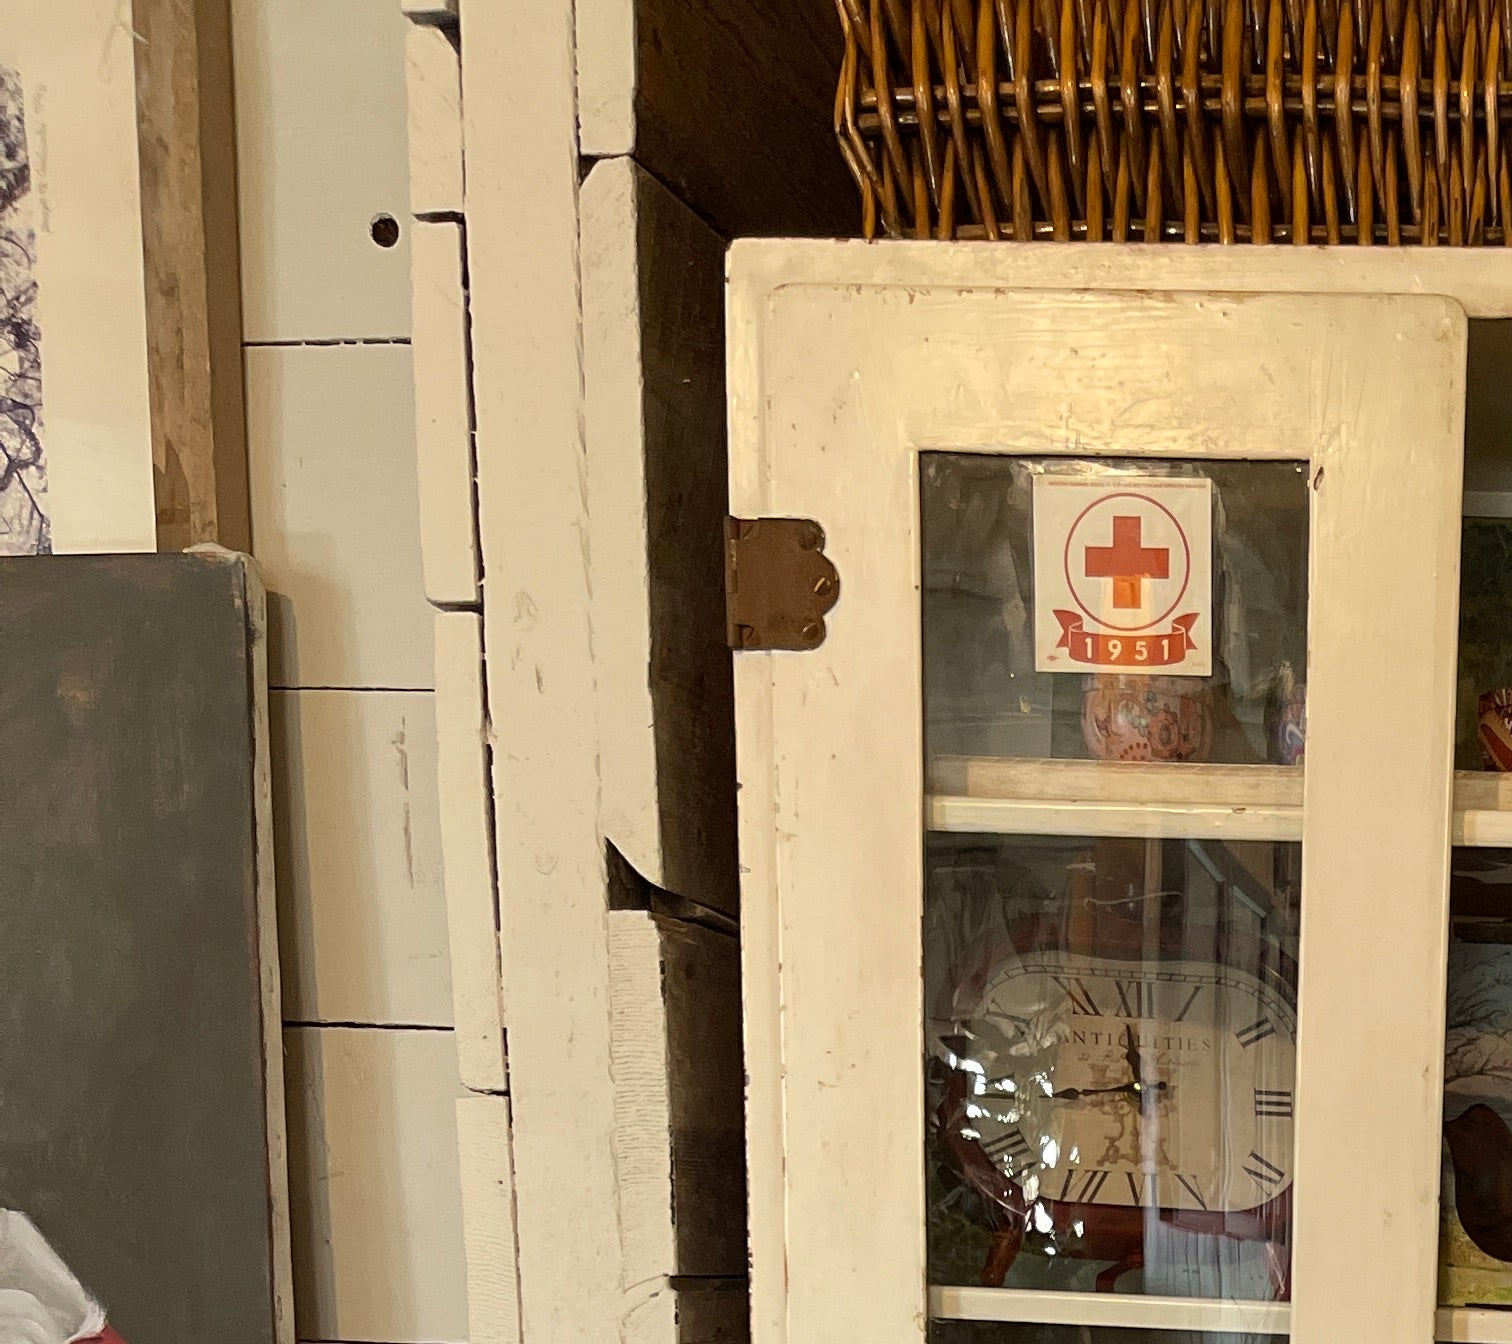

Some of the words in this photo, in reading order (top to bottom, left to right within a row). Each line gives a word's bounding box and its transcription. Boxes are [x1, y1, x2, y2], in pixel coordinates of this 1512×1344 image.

[1084, 637, 1171, 662] 1951
[1113, 980, 1158, 1019] XII
[1234, 1015, 1279, 1048] II
[1254, 1088, 1294, 1117] III
[1060, 1168, 1112, 1203] VII
[1171, 1172, 1208, 1210] V
